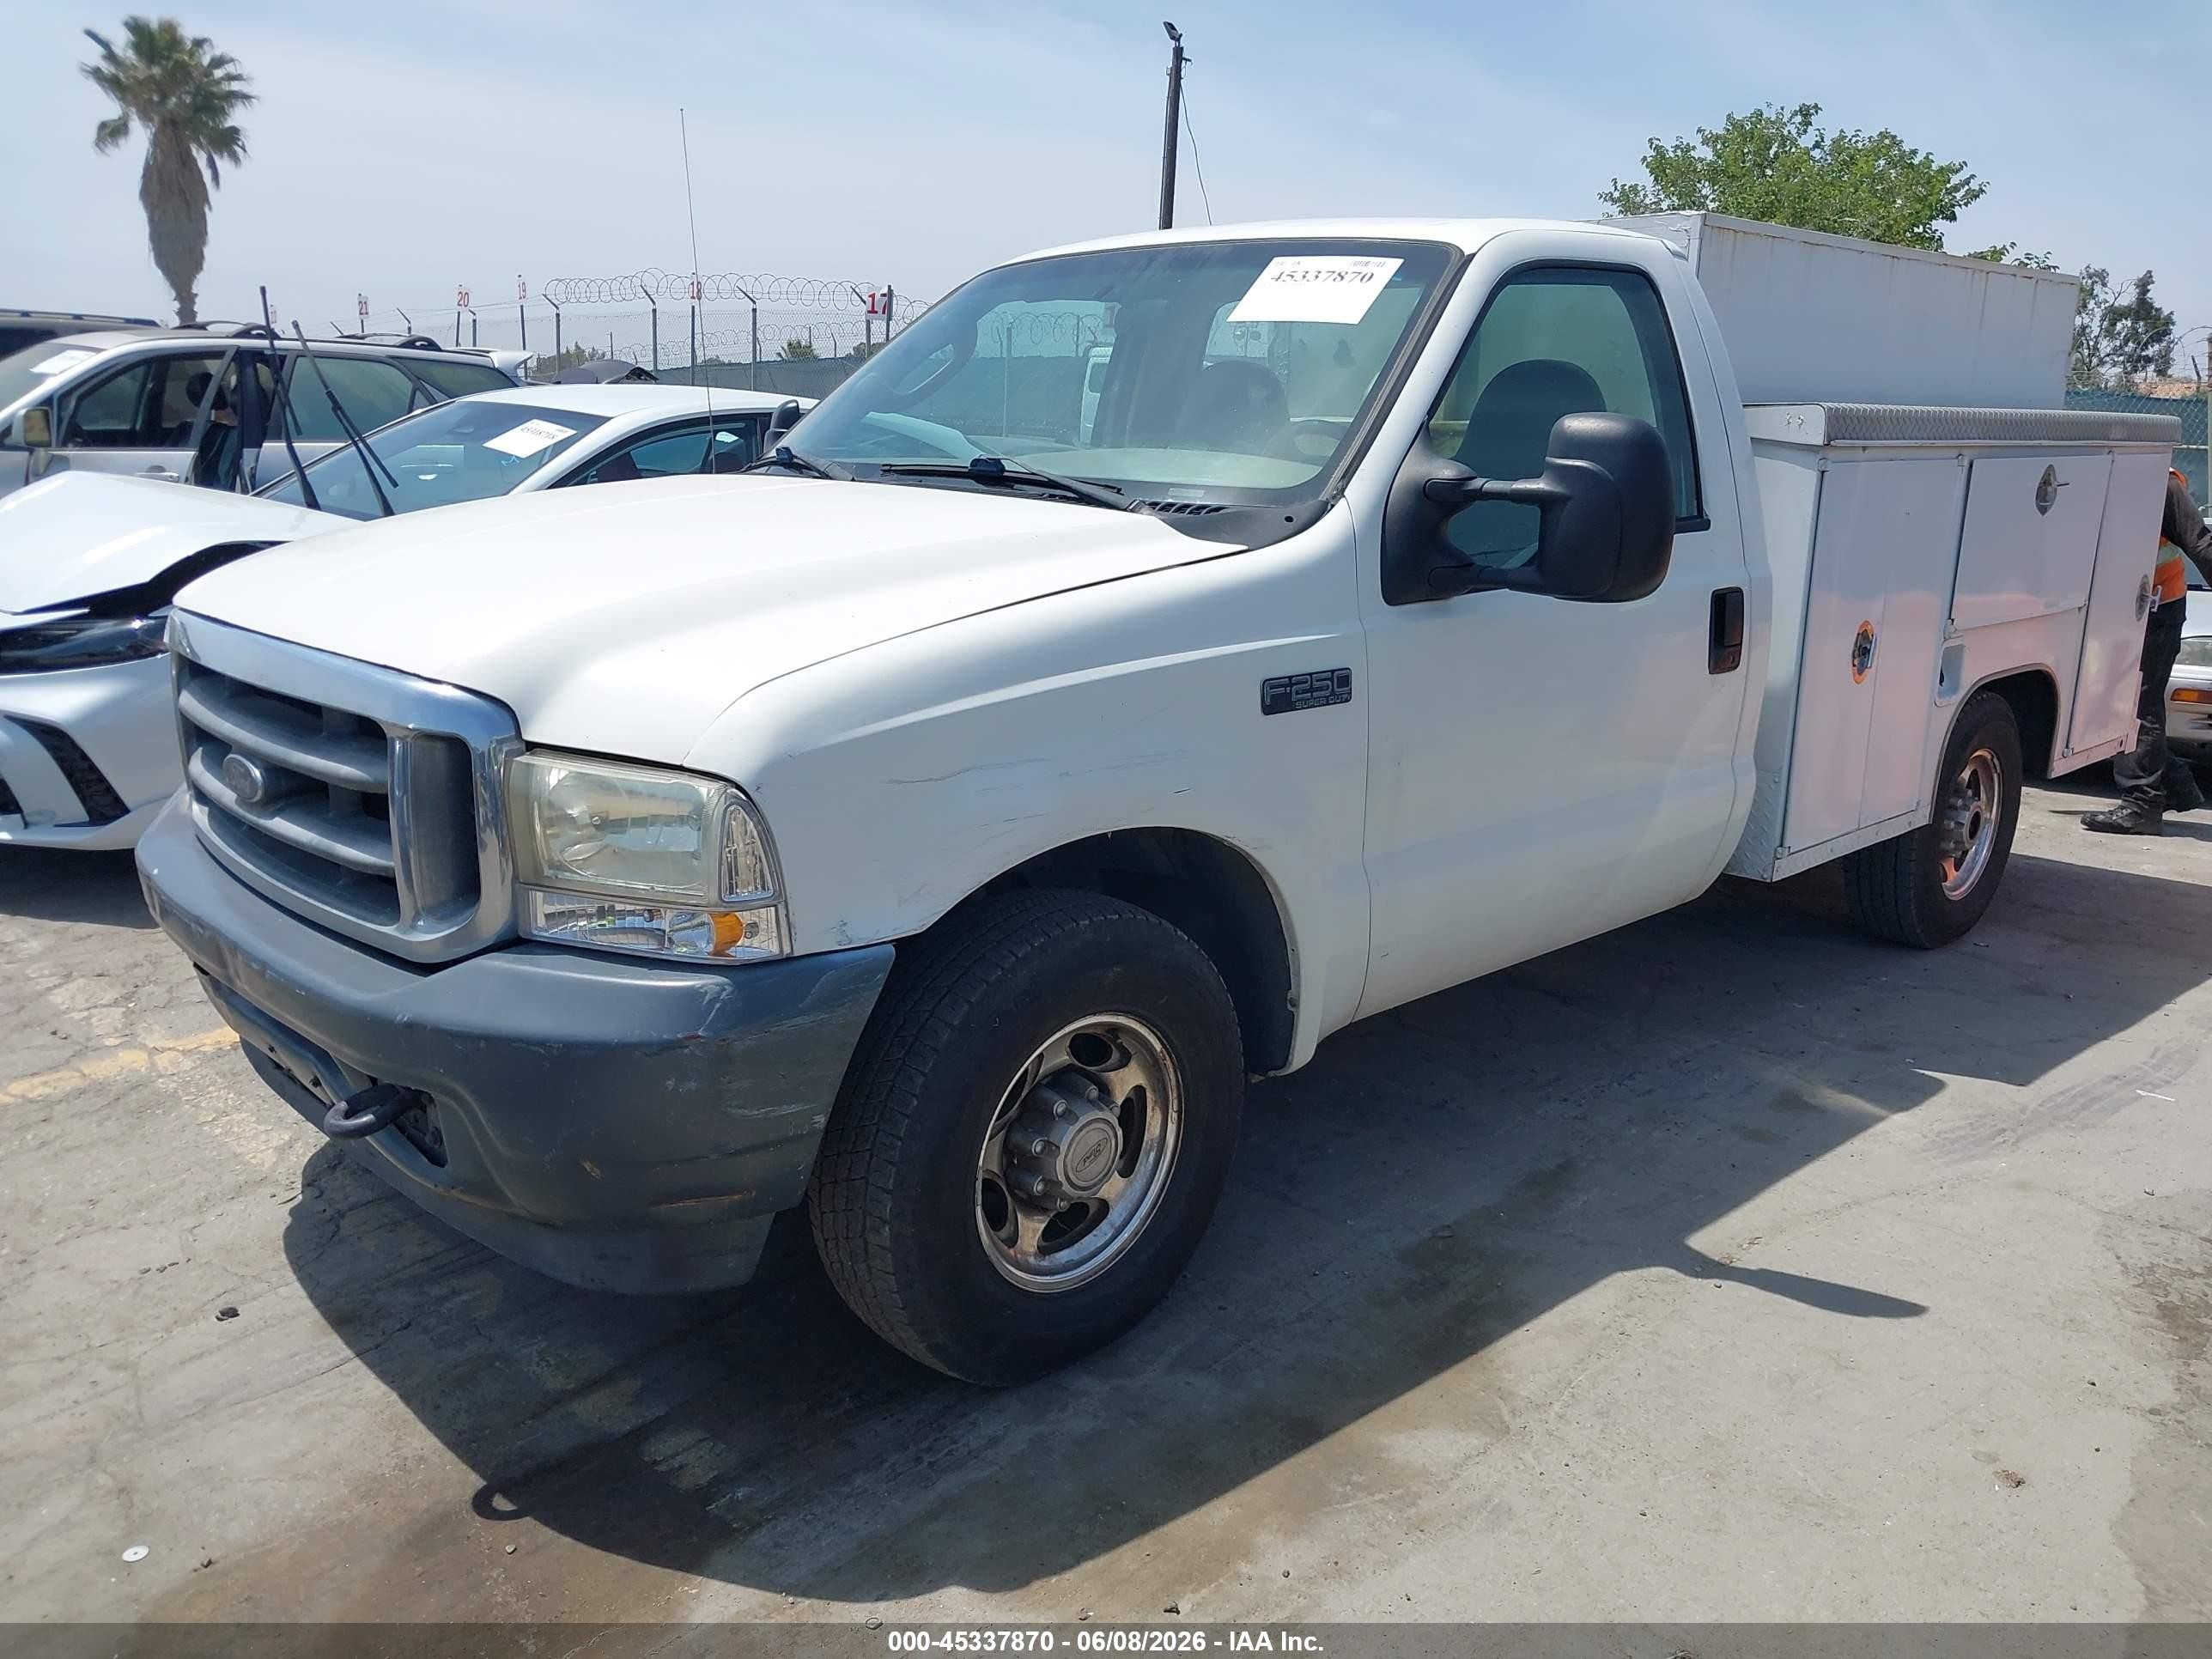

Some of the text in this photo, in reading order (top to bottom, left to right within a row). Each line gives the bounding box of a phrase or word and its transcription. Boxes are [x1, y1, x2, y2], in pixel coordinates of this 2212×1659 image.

[1271, 270, 1375, 283] 45337870
[518, 281, 526, 300] 19
[690, 280, 702, 301] 18
[457, 291, 470, 307] 20
[866, 292, 889, 315] 17
[358, 301, 369, 316] 21
[1295, 693, 1351, 709] SUPER DUTY
